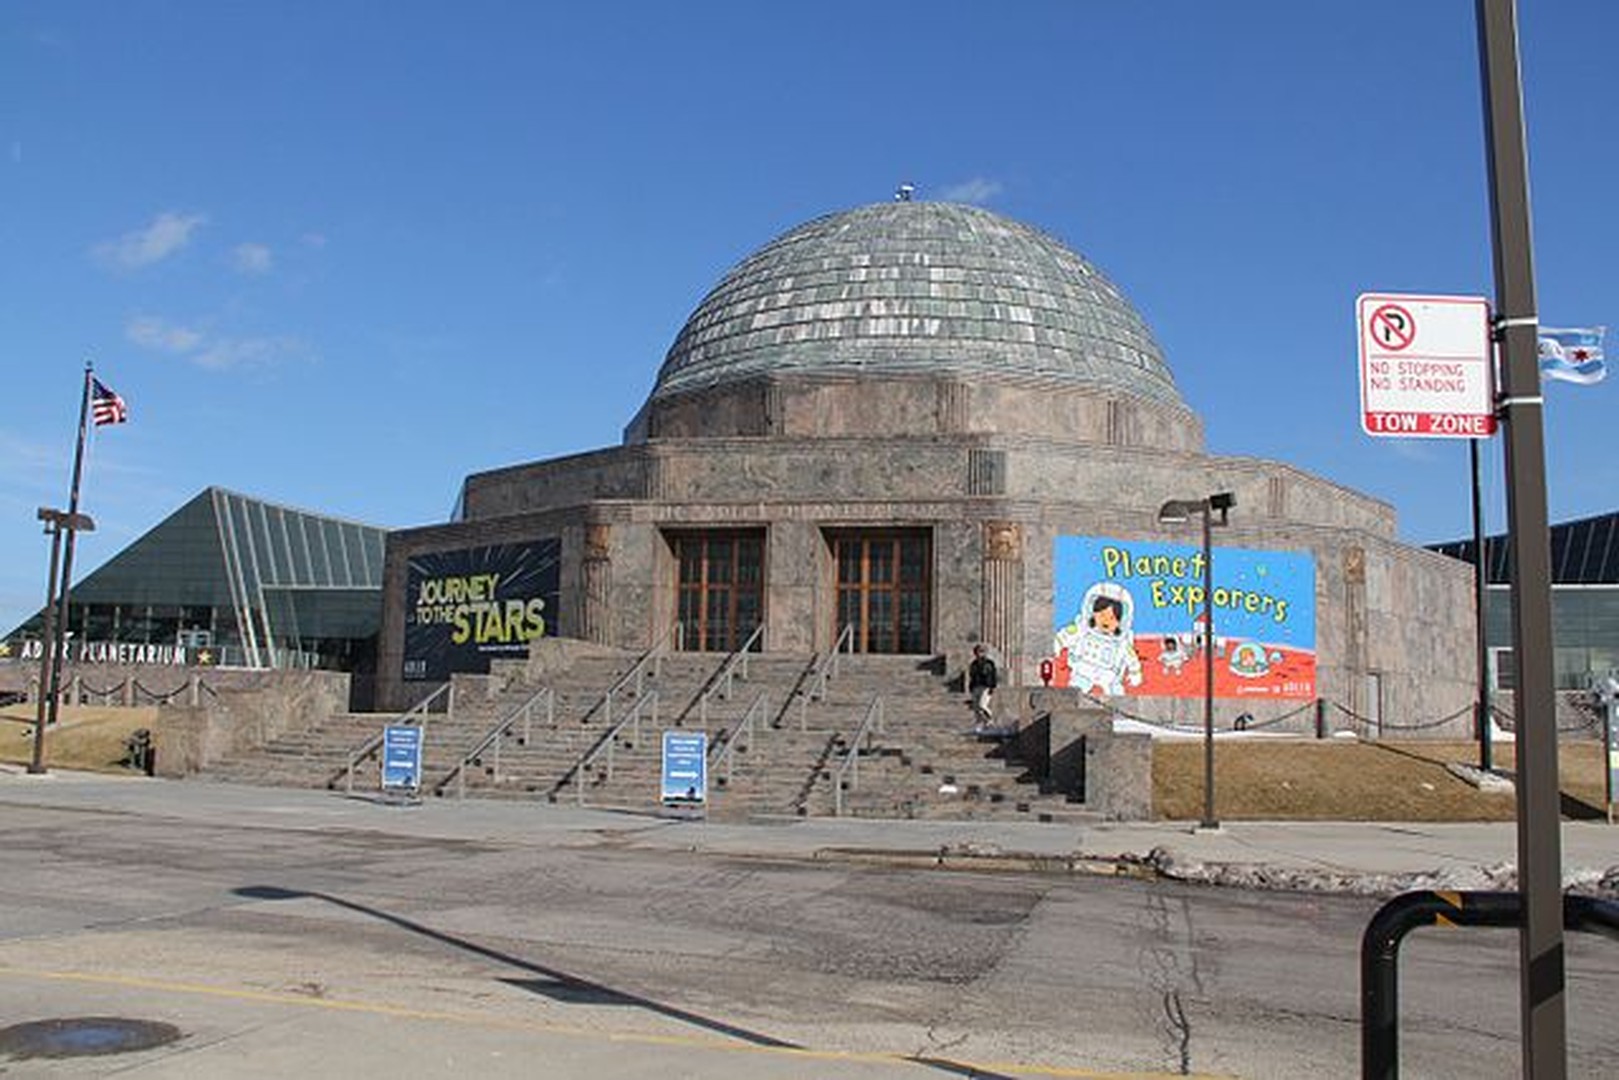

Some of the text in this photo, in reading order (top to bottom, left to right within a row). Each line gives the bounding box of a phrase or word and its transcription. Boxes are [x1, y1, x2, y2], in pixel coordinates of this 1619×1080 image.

[1370, 362, 1464, 377] NO STOPPING
[1371, 378, 1466, 393] NO STANDING
[1374, 413, 1488, 433] TOW ZONE
[1102, 546, 1207, 579] Planet
[416, 573, 500, 605] JOURNEY
[1151, 580, 1289, 622] Exporers
[416, 598, 546, 645] TO THE STARS
[80, 642, 187, 665] PLANETARIUM
